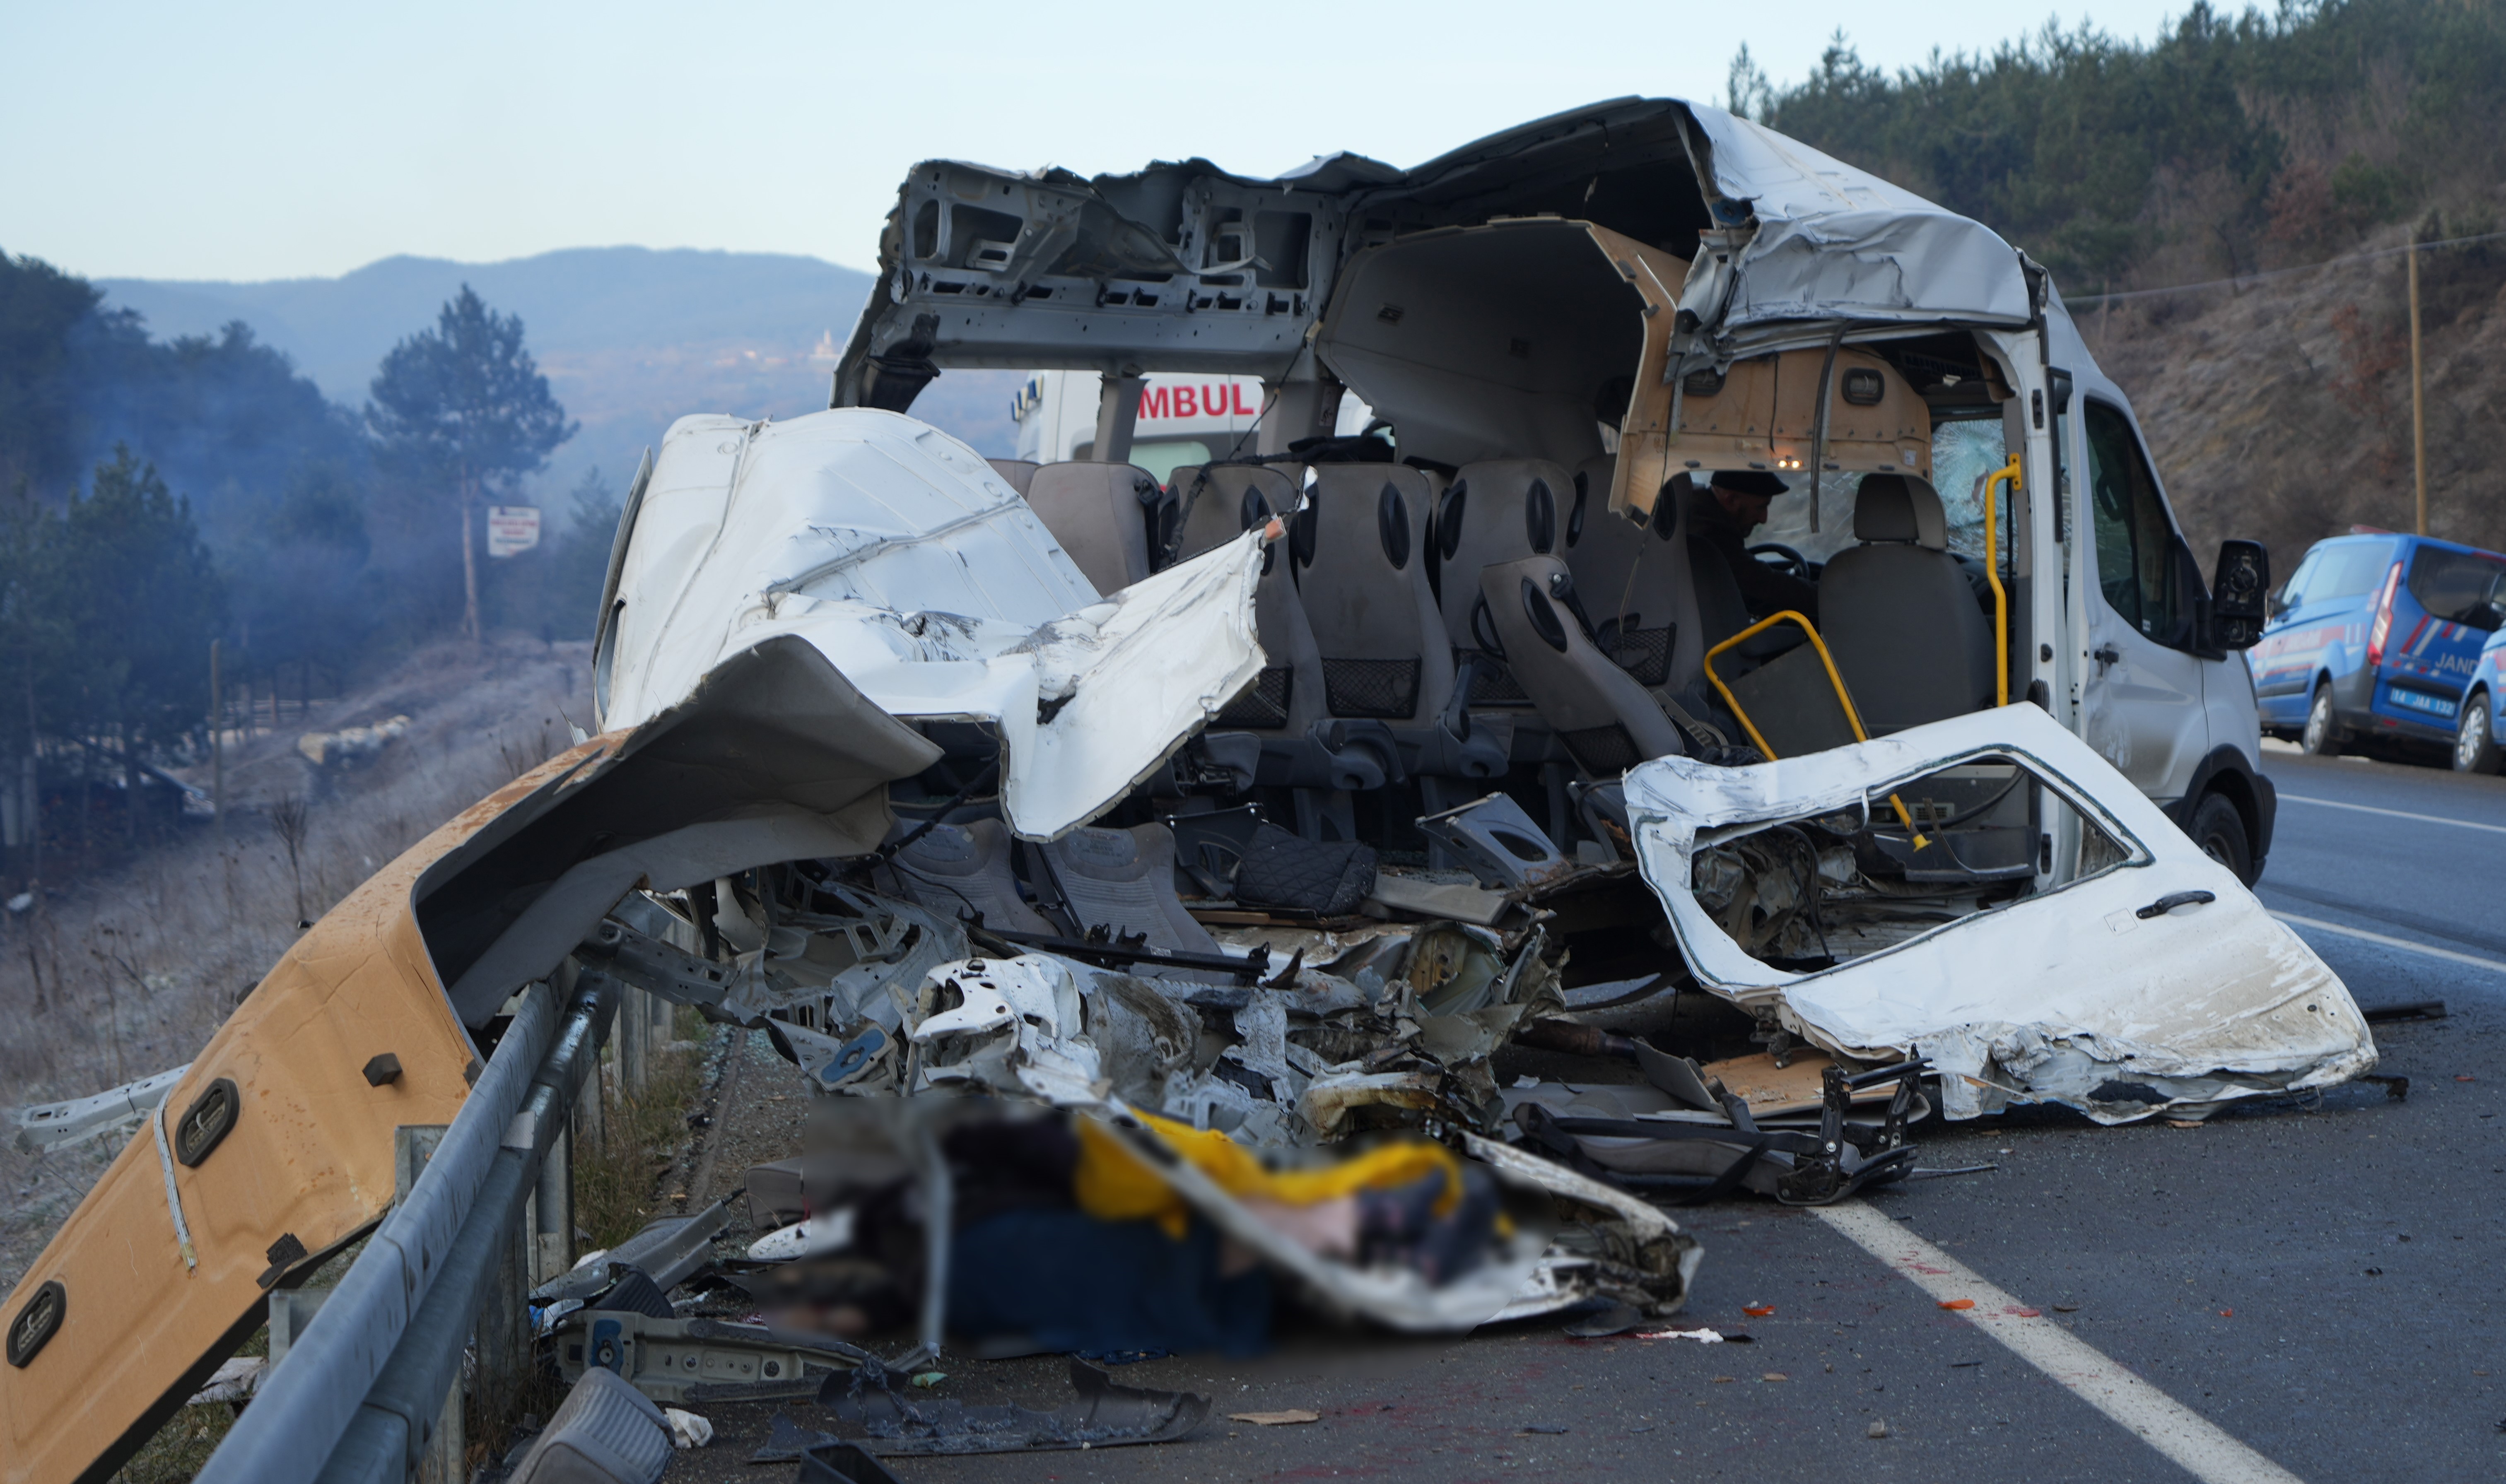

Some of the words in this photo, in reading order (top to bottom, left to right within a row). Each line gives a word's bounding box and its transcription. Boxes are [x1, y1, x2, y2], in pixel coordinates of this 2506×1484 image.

[1138, 383, 1264, 419] MBUL
[2395, 690, 2406, 702] 14
[2413, 695, 2430, 708] JAA
[2436, 699, 2453, 714] 132
